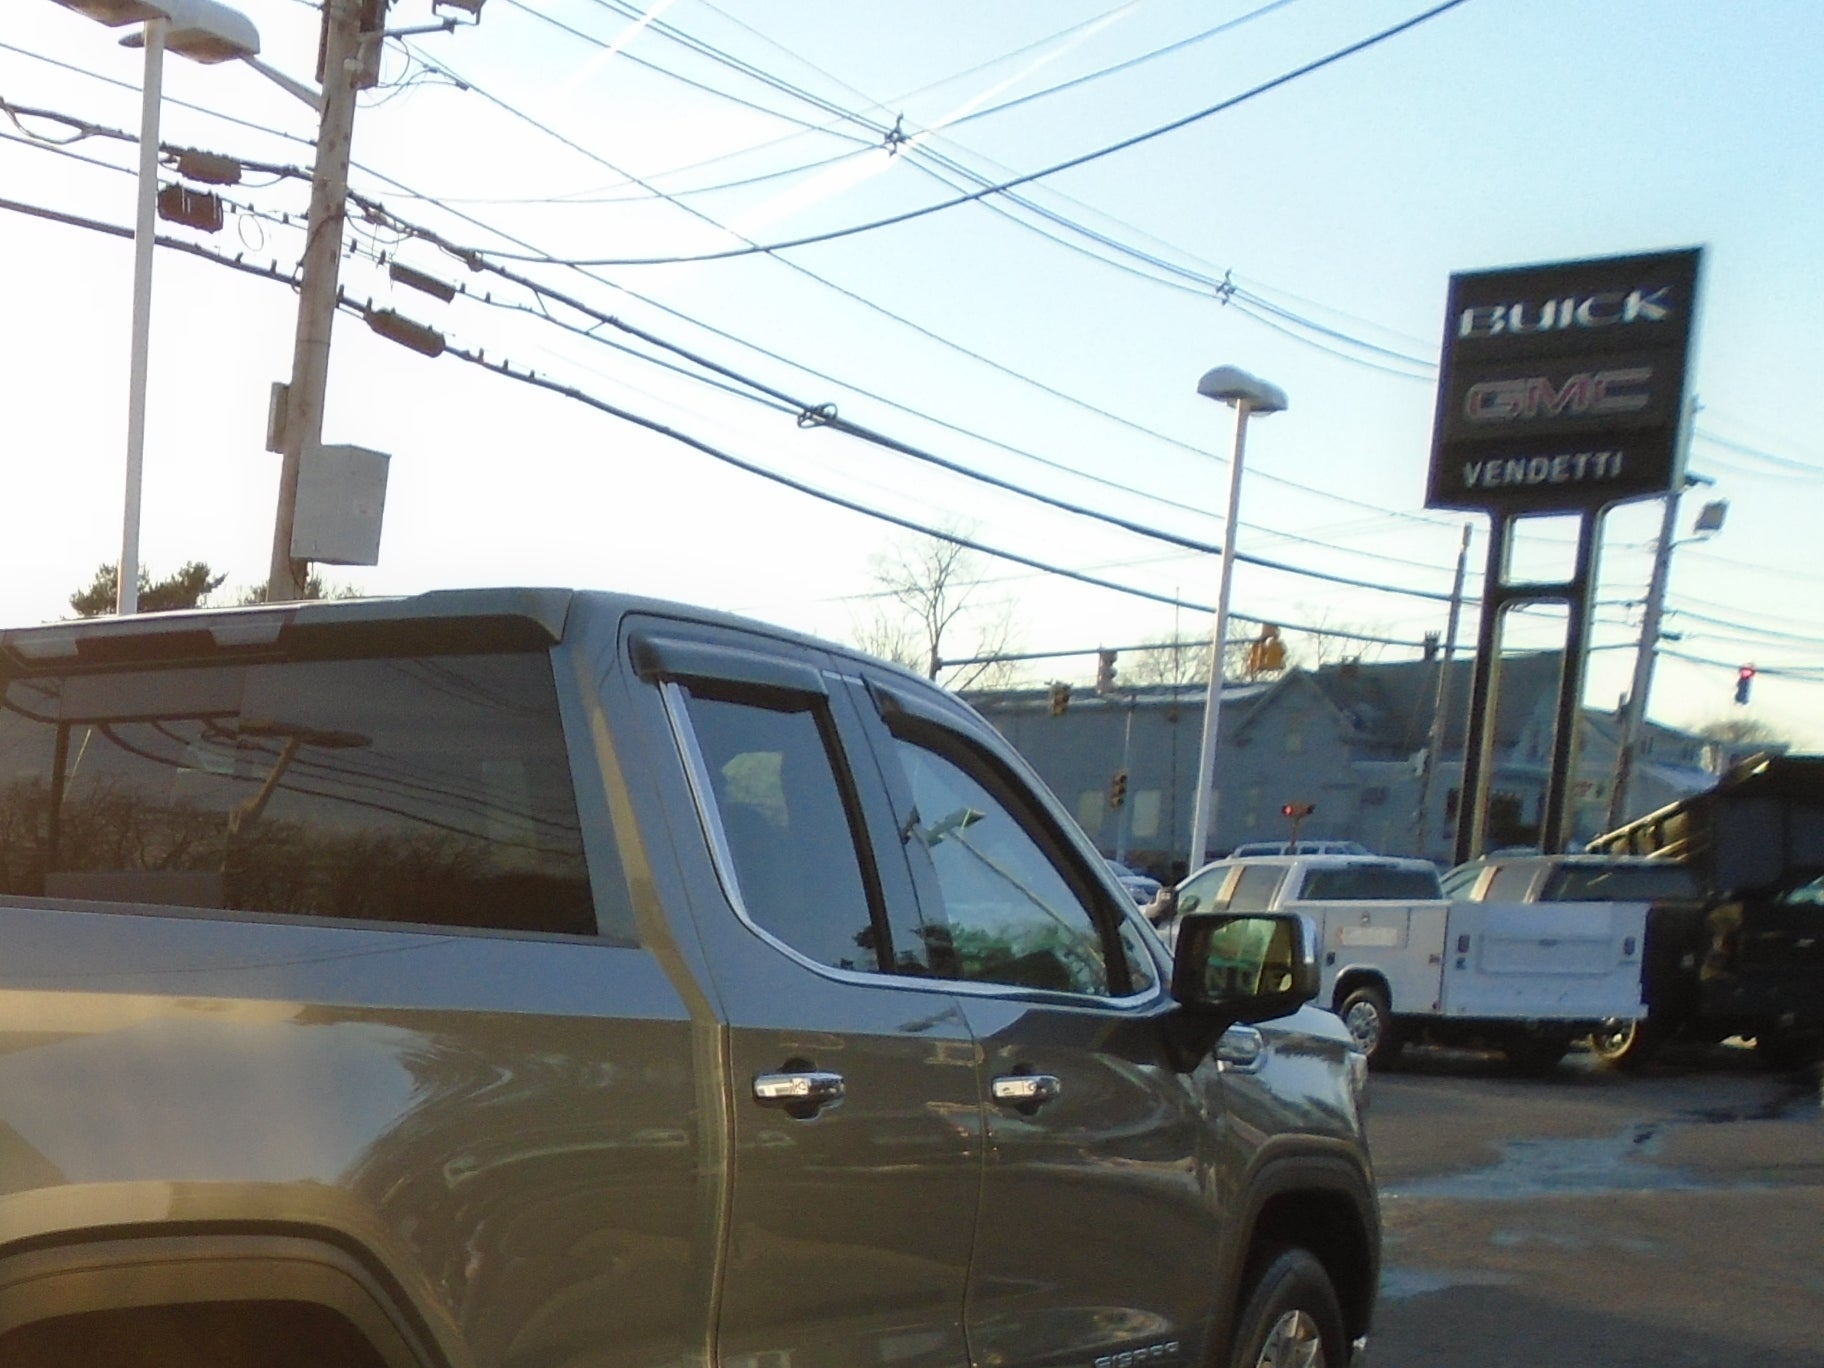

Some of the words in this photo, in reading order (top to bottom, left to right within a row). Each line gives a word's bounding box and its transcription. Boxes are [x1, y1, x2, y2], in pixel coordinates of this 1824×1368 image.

[1458, 286, 1673, 338] BUICK
[1467, 367, 1653, 424] GMC
[1462, 451, 1625, 489] VENDETTI
